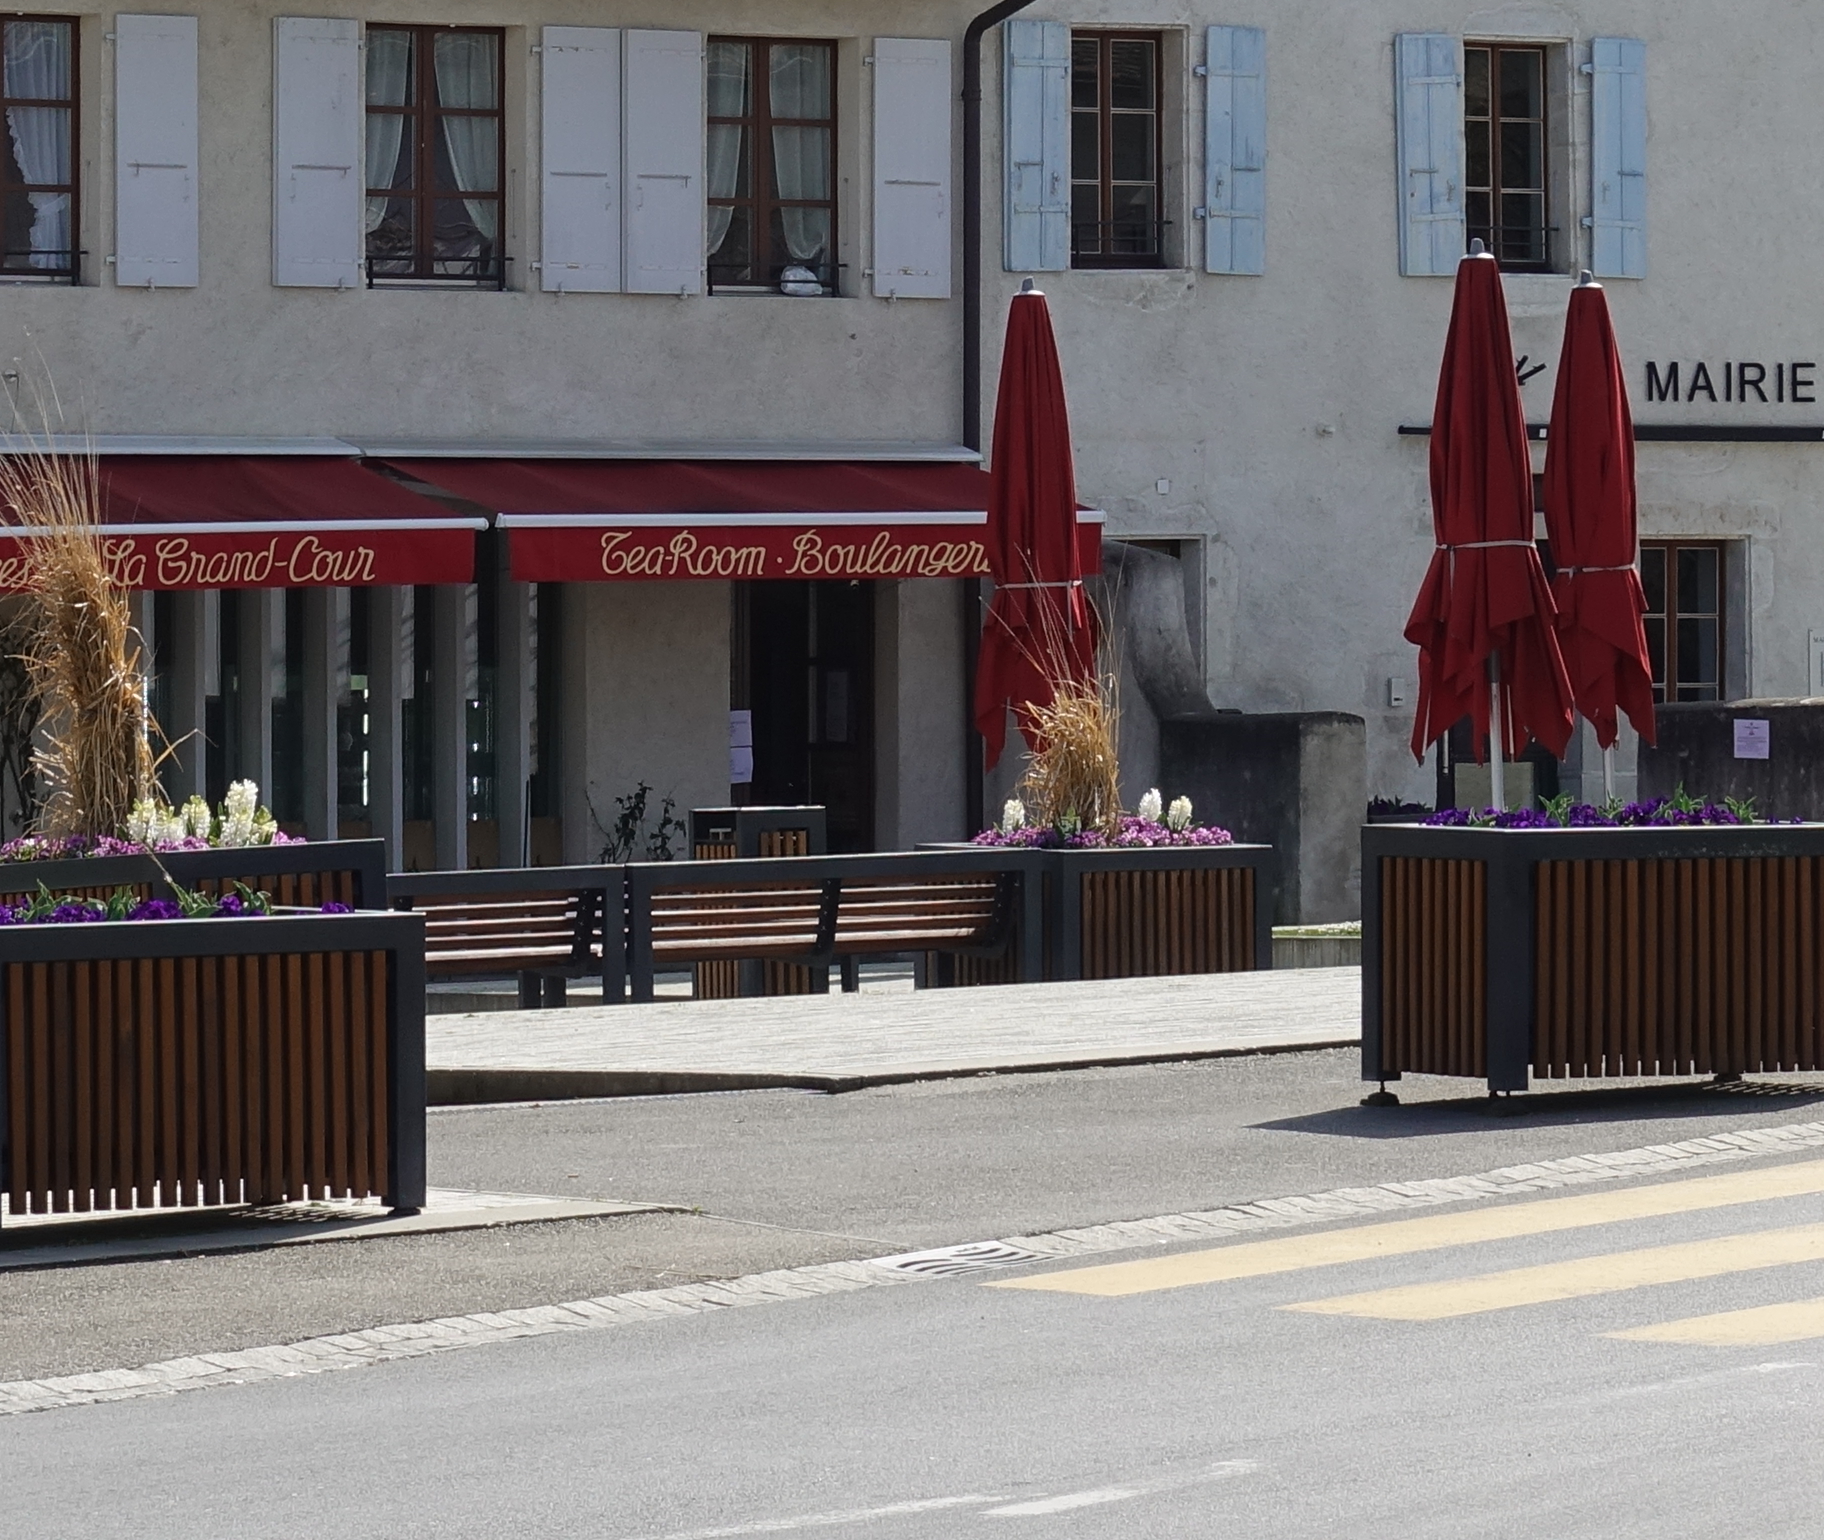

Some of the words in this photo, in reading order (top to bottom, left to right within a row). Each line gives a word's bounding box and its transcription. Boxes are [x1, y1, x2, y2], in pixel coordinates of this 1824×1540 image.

[1646, 360, 1817, 403] MAIRIE
[155, 534, 376, 586] Grand-Cour
[601, 529, 767, 576] Tea-Room
